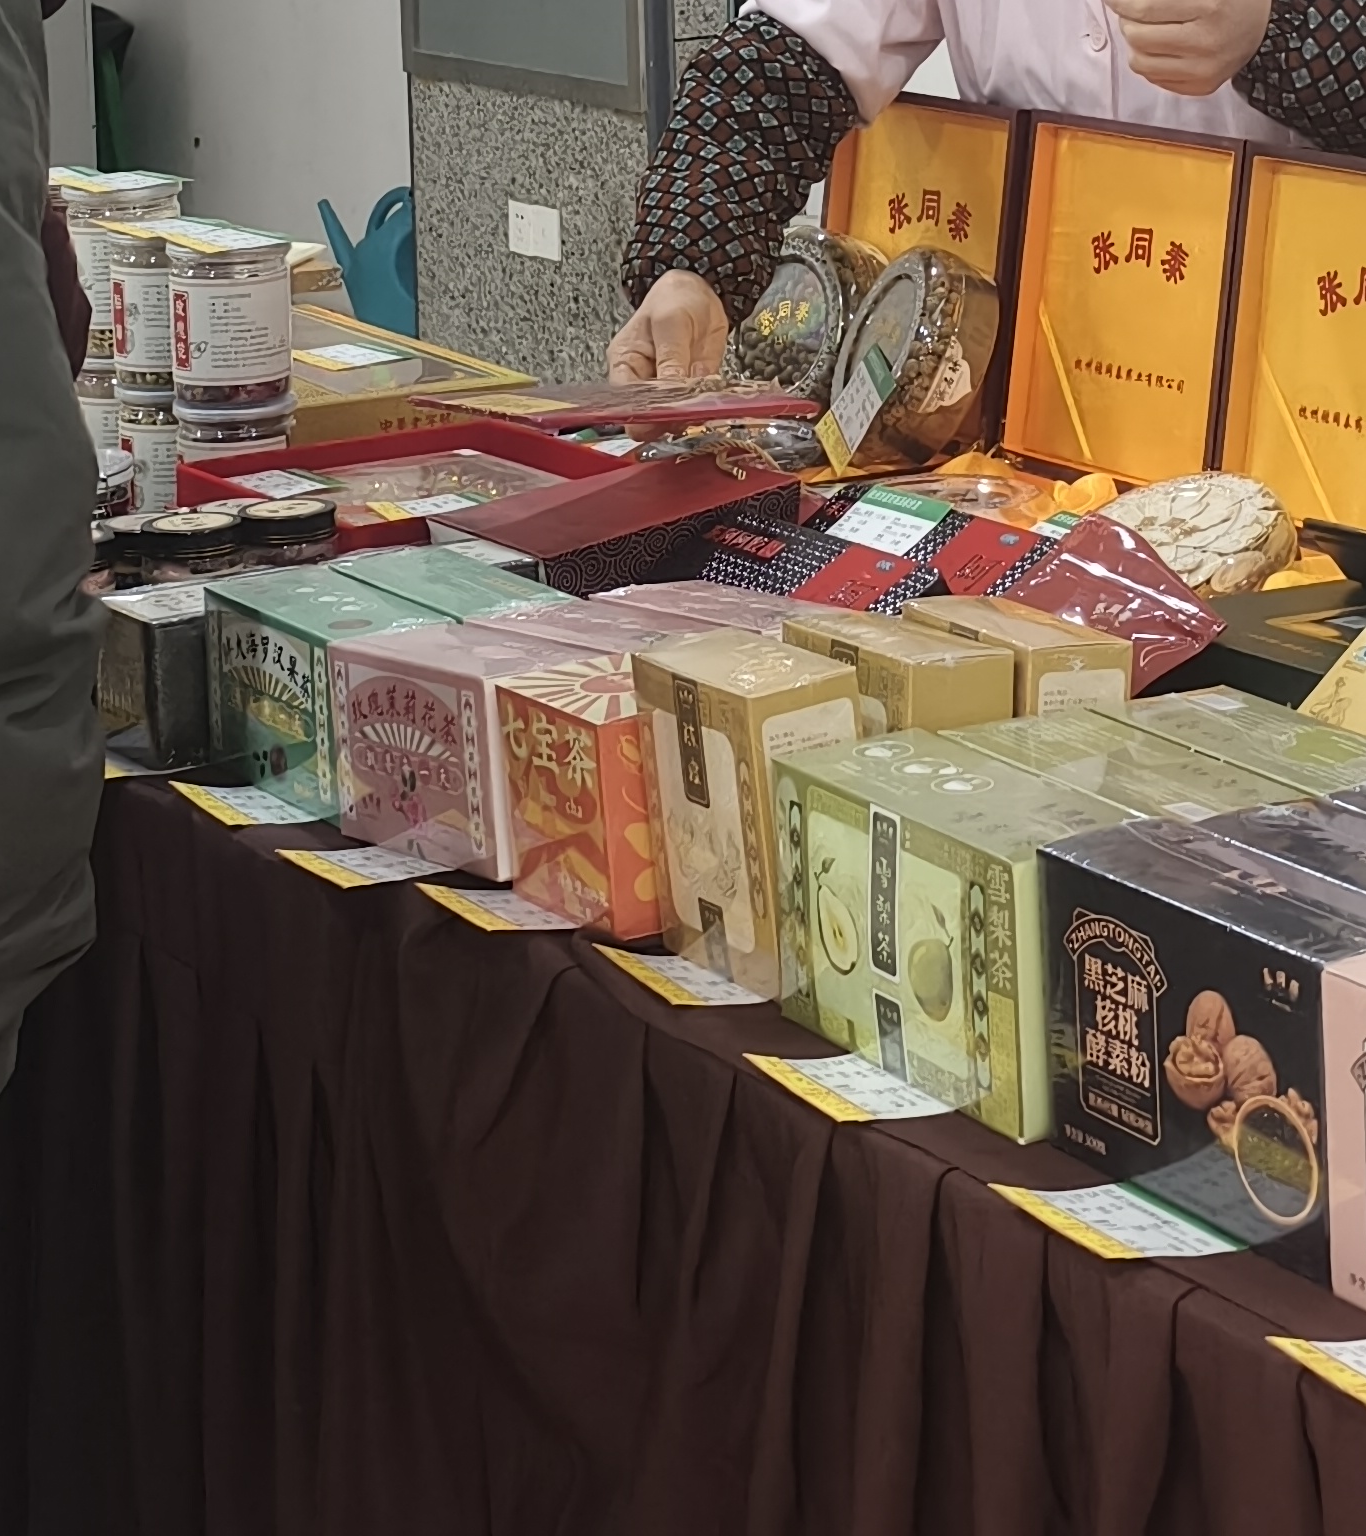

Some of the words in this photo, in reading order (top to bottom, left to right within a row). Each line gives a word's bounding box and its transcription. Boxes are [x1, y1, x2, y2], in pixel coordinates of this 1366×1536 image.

[888, 189, 972, 243] 张同泰
[1091, 226, 1189, 285] 张同泰
[502, 702, 597, 790] 七宝茶
[986, 865, 1014, 991] 雪梨茶
[1072, 920, 1160, 986] ZHANGTONGTAI
[1083, 952, 1149, 1013] 黑芝麻
[1095, 995, 1139, 1046] 核桃
[1085, 1027, 1150, 1088] 酵素粉
